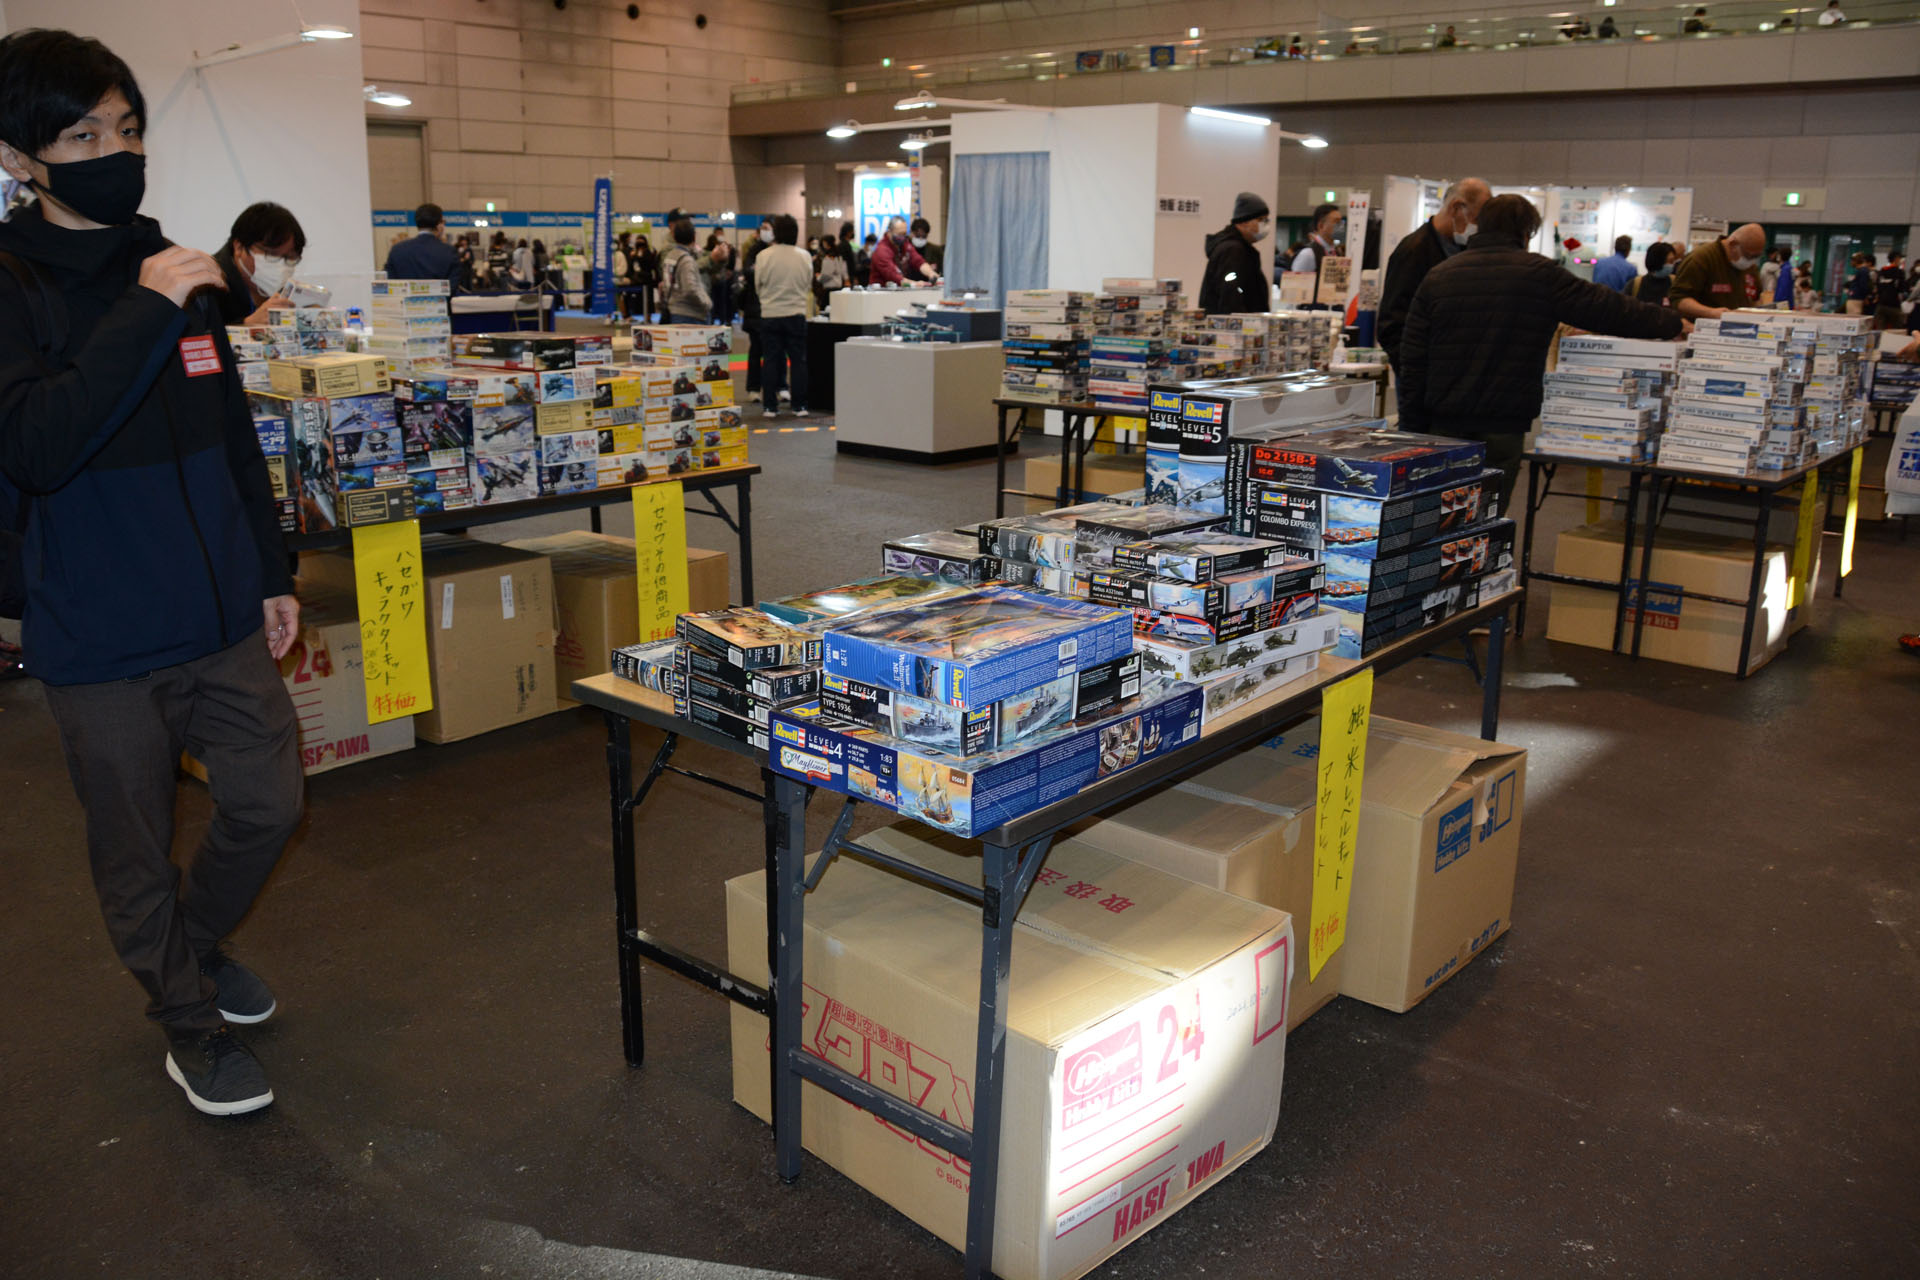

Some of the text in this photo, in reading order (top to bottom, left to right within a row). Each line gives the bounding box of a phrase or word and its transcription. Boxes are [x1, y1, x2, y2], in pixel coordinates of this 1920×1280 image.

[863, 187, 911, 215] BAN
[1580, 341, 1613, 350] RAPTOR
[1153, 393, 1180, 409] Revell
[1185, 402, 1214, 419] Revell
[1150, 412, 1178, 424] LEVEL
[1182, 423, 1222, 444] LEVEL 5
[1256, 448, 1272, 459] Do
[1246, 507, 1256, 516] 5
[1263, 492, 1316, 511] Revell LEVEL 4
[1260, 515, 1316, 530] COLOMBO EXPRESS
[649, 491, 671, 621] ハセガワその他商品
[1303, 552, 1309, 560] 4
[1016, 566, 1023, 578] VW
[1094, 574, 1107, 586] Revell
[1124, 581, 1130, 590] 4
[396, 551, 418, 620] ハセガワ
[374, 571, 400, 686] キャラクターキット
[824, 676, 877, 703] Revell LEVEL 4
[952, 668, 964, 699] Revell
[373, 692, 416, 716] 特価
[822, 697, 852, 713] TYPE 1936
[967, 709, 991, 734] Revell LEVEL 4
[775, 723, 843, 759] Revell LEVEL 4
[790, 751, 828, 773] Mayflower
[880, 753, 893, 764] 1:83
[1317, 760, 1335, 878] アウトレット
[1035, 867, 1136, 914] 取扱注
[1313, 912, 1340, 961] 特価
[1470, 919, 1500, 953] セガワ
[829, 997, 909, 1060] 超時空要塞
[946, 1173, 962, 1190] BIG
